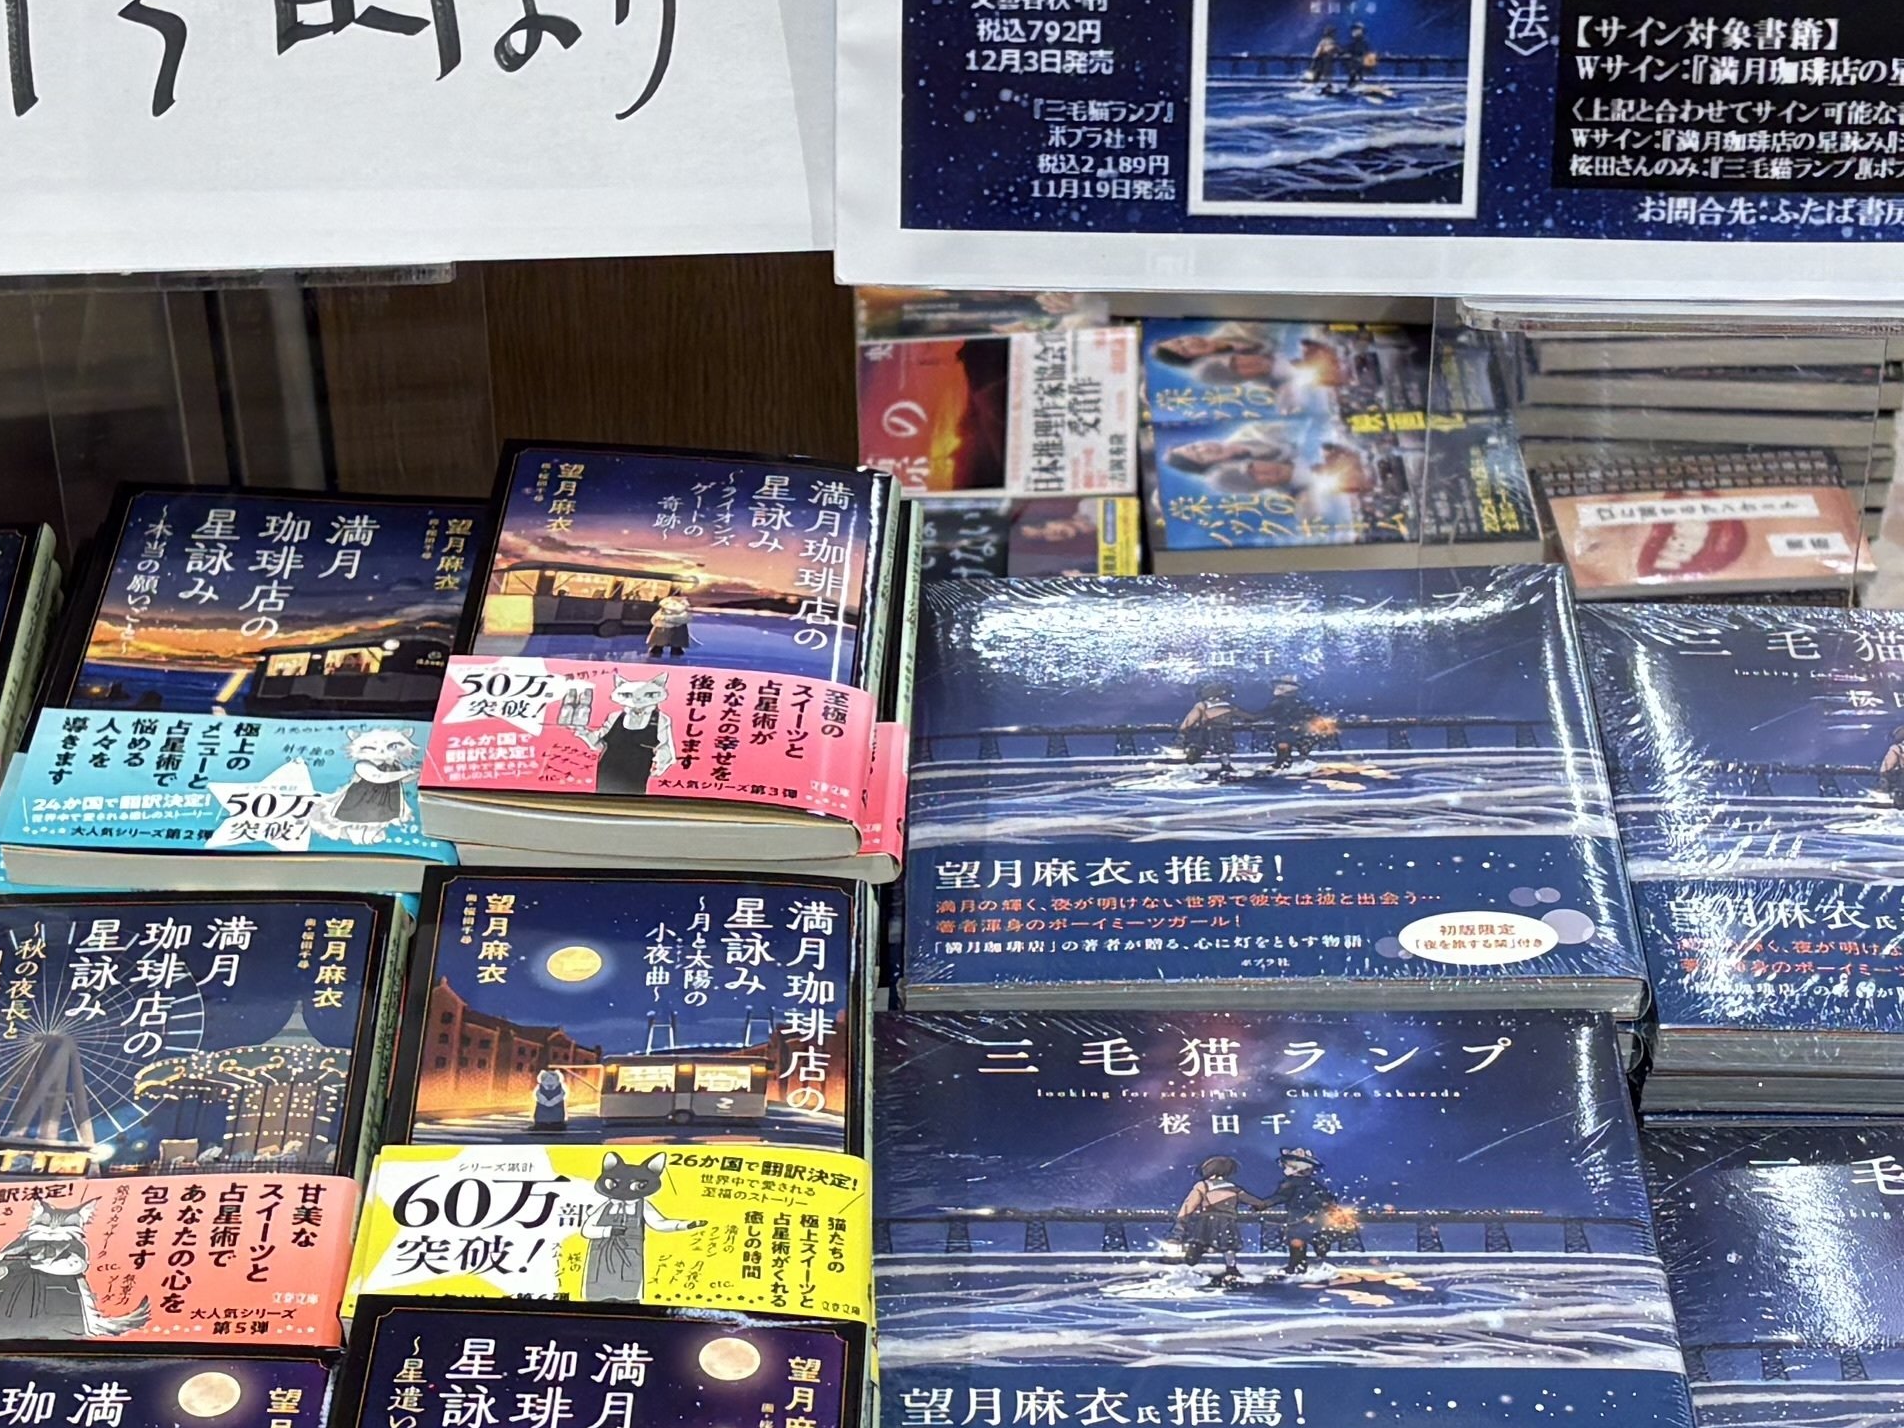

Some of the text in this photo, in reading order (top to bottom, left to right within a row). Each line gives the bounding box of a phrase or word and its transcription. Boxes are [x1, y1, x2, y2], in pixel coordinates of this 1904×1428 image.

[965, 50, 1114, 74] 12月3日発売
[977, 20, 1101, 43] 税込792円
[1572, 16, 1840, 51] 【サイン対象書籍】
[1033, 98, 1174, 123] 『三毛猫ランプ』
[1048, 128, 1157, 149] ポプラ社・刊
[1030, 179, 1175, 200] 11月19日発売
[1037, 154, 1169, 175] 税込2,189円
[547, 462, 585, 533] 望月麻衣
[748, 474, 797, 553] 星詠み
[178, 509, 241, 605] 星詠み
[238, 513, 311, 639] 珈琲店の
[319, 515, 380, 580] 満月
[433, 518, 474, 591] 望月麻衣
[793, 479, 855, 651] 満月珈琲店の
[88, 719, 122, 768] 人々を
[123, 719, 159, 768] 悩める
[709, 677, 748, 782] あなたの幸せを
[749, 679, 784, 744] 占星術が
[784, 683, 816, 760] スイーツと
[821, 688, 853, 739] 至極の
[153, 719, 193, 788] 占星術で
[187, 721, 224, 789] メニューと
[227, 721, 263, 771] 極上の
[935, 854, 1287, 891] 望月麻衣氏推薦!
[64, 919, 123, 1022] 星詠み
[200, 917, 258, 989] 満月
[312, 918, 354, 1010] 望月麻衣
[477, 893, 516, 985] 望月麻衣
[723, 896, 776, 995] 星詠み
[123, 919, 193, 1058] 珈琲店の
[778, 900, 839, 1115] 満月珈琲店の
[977, 1035, 1516, 1080] 三毛猫ランプ
[1158, 1111, 1346, 1137] 桜田千尋
[128, 1183, 170, 1270] 包みます
[161, 1183, 214, 1314] あなたの心を
[209, 1183, 248, 1269] 占星術で
[245, 1183, 284, 1283] スイーツと
[292, 1183, 327, 1249] 甘美な
[393, 1236, 549, 1276] 突破!
[212, 1321, 270, 1335] 第5弾
[900, 1386, 1308, 1428] 望月麻衣氏推薦!
